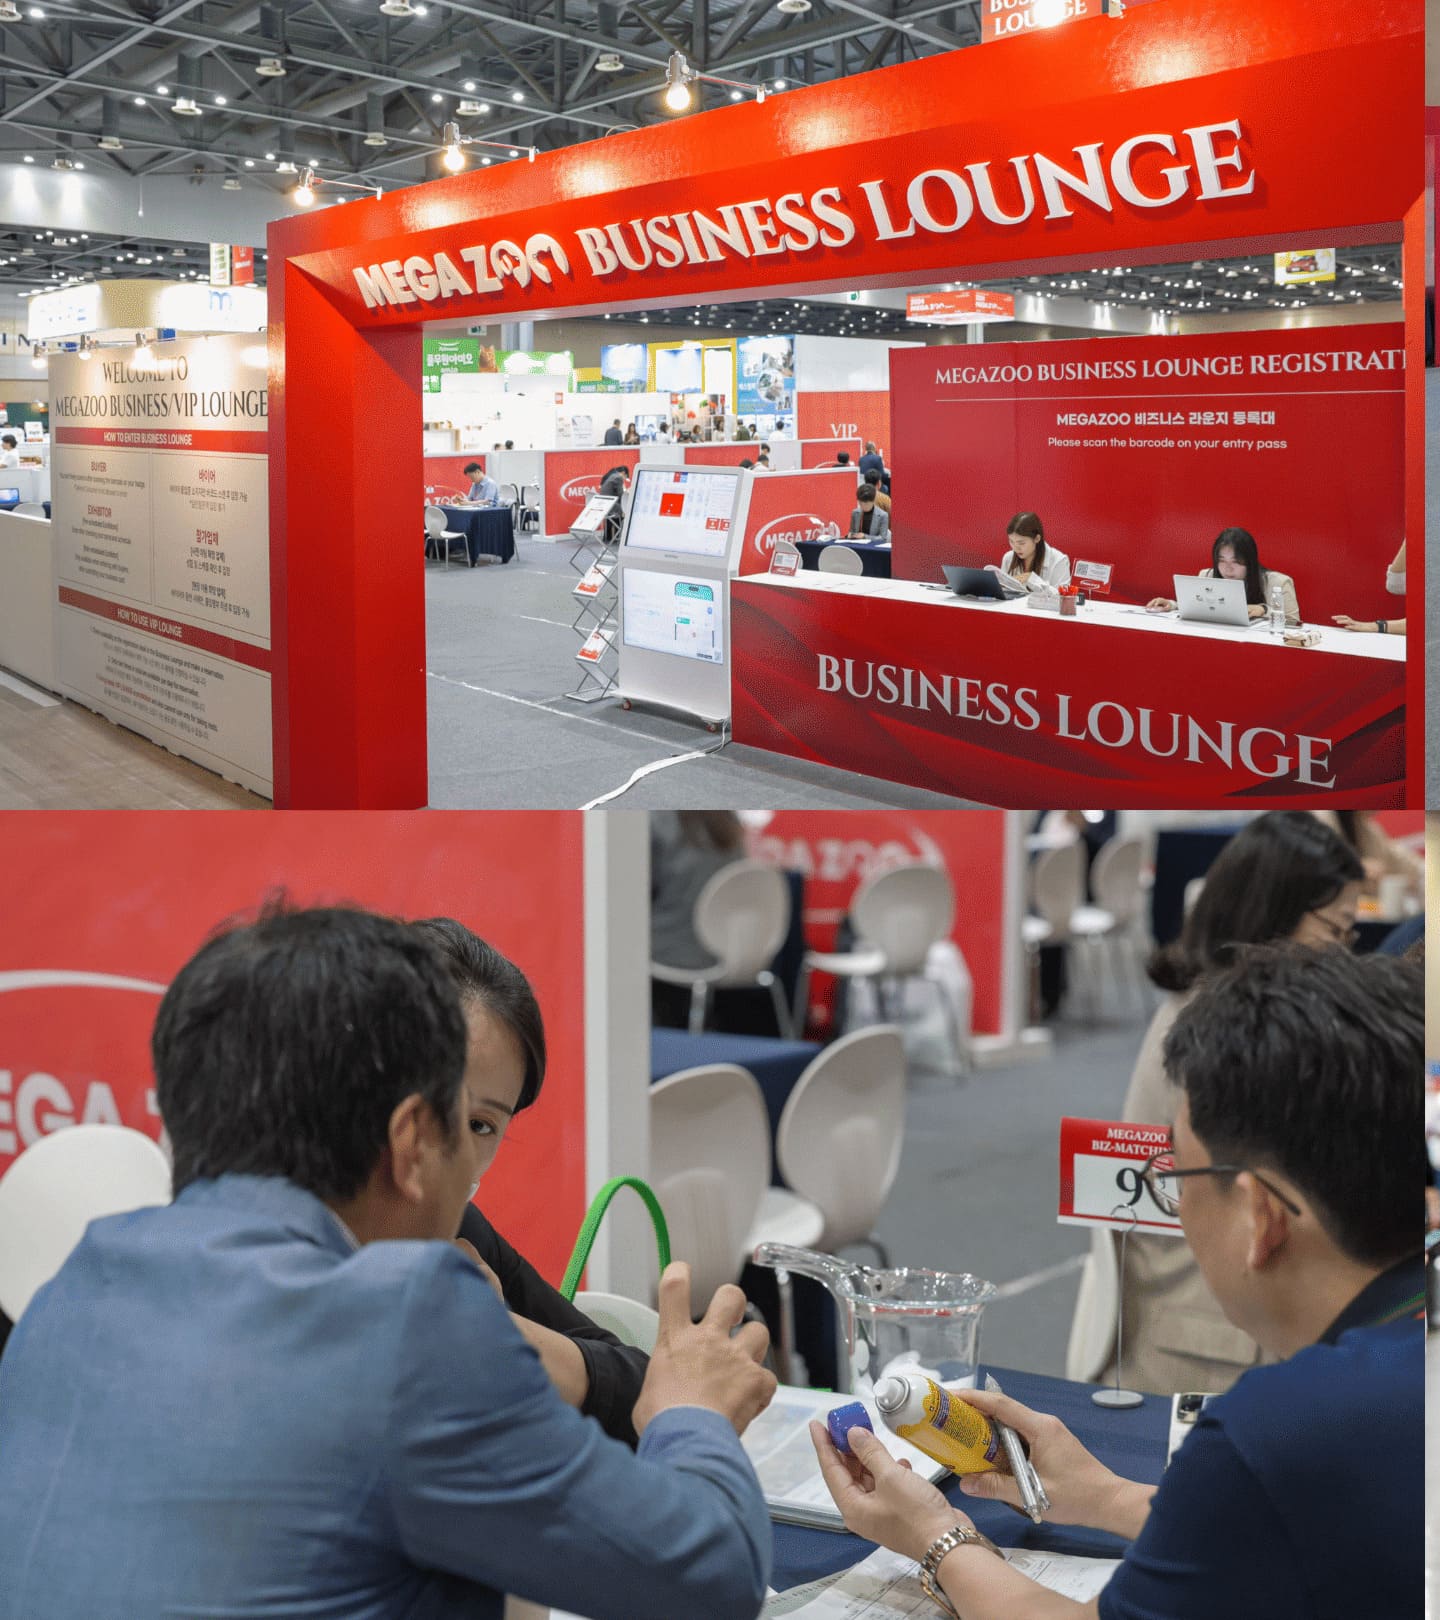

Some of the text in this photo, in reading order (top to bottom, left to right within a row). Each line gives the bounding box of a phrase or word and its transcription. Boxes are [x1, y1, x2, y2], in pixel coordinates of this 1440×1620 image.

[995, 1, 1088, 36] LOUGE
[574, 180, 856, 278] BUSINESS
[858, 117, 1257, 243] LOUNGE
[103, 355, 188, 384] WELCOME TO
[935, 363, 1033, 385] MEGAZOO
[1037, 360, 1137, 382] BUSINESS
[1142, 355, 1244, 379] LOUNGE
[56, 389, 268, 418] MEGAZOO BUSINESS/VIP LOUNGE
[830, 423, 859, 438] VIP
[1056, 411, 1276, 426] MEGAZOO 비즈니스 라운지 등록대
[1048, 437, 1288, 450] Please scan the barcode on your entry pass
[815, 652, 1338, 790] BUSINESS LOUNGE
[1107, 1127, 1167, 1144] MEGAZOO
[1115, 1167, 1143, 1206] 9
